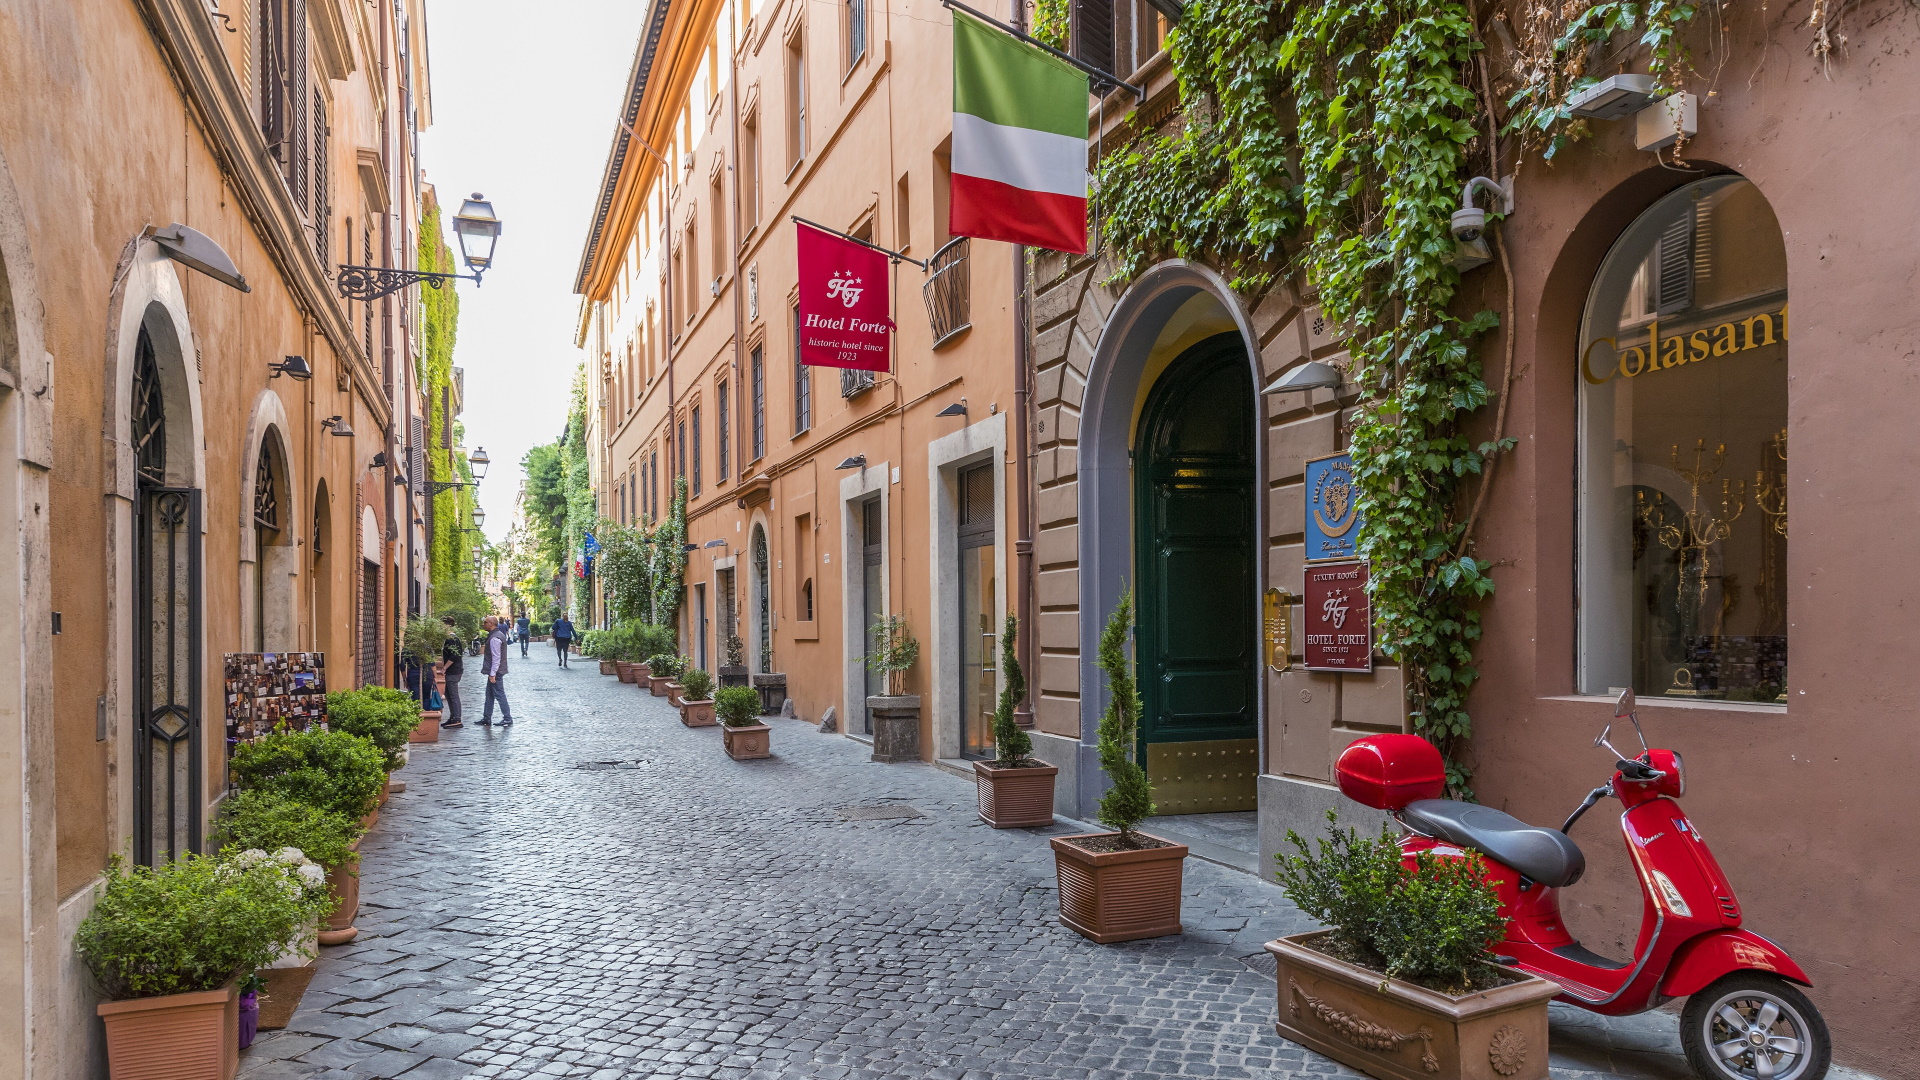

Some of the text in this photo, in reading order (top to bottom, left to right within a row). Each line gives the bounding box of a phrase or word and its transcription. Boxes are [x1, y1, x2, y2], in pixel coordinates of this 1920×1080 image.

[805, 313, 886, 334] Hotel Forte
[808, 338, 884, 352] historic hotel since
[837, 351, 857, 361] 1923
[1313, 571, 1358, 582] LUXURY ROOMS
[1307, 634, 1366, 645] HOTEL FORTE
